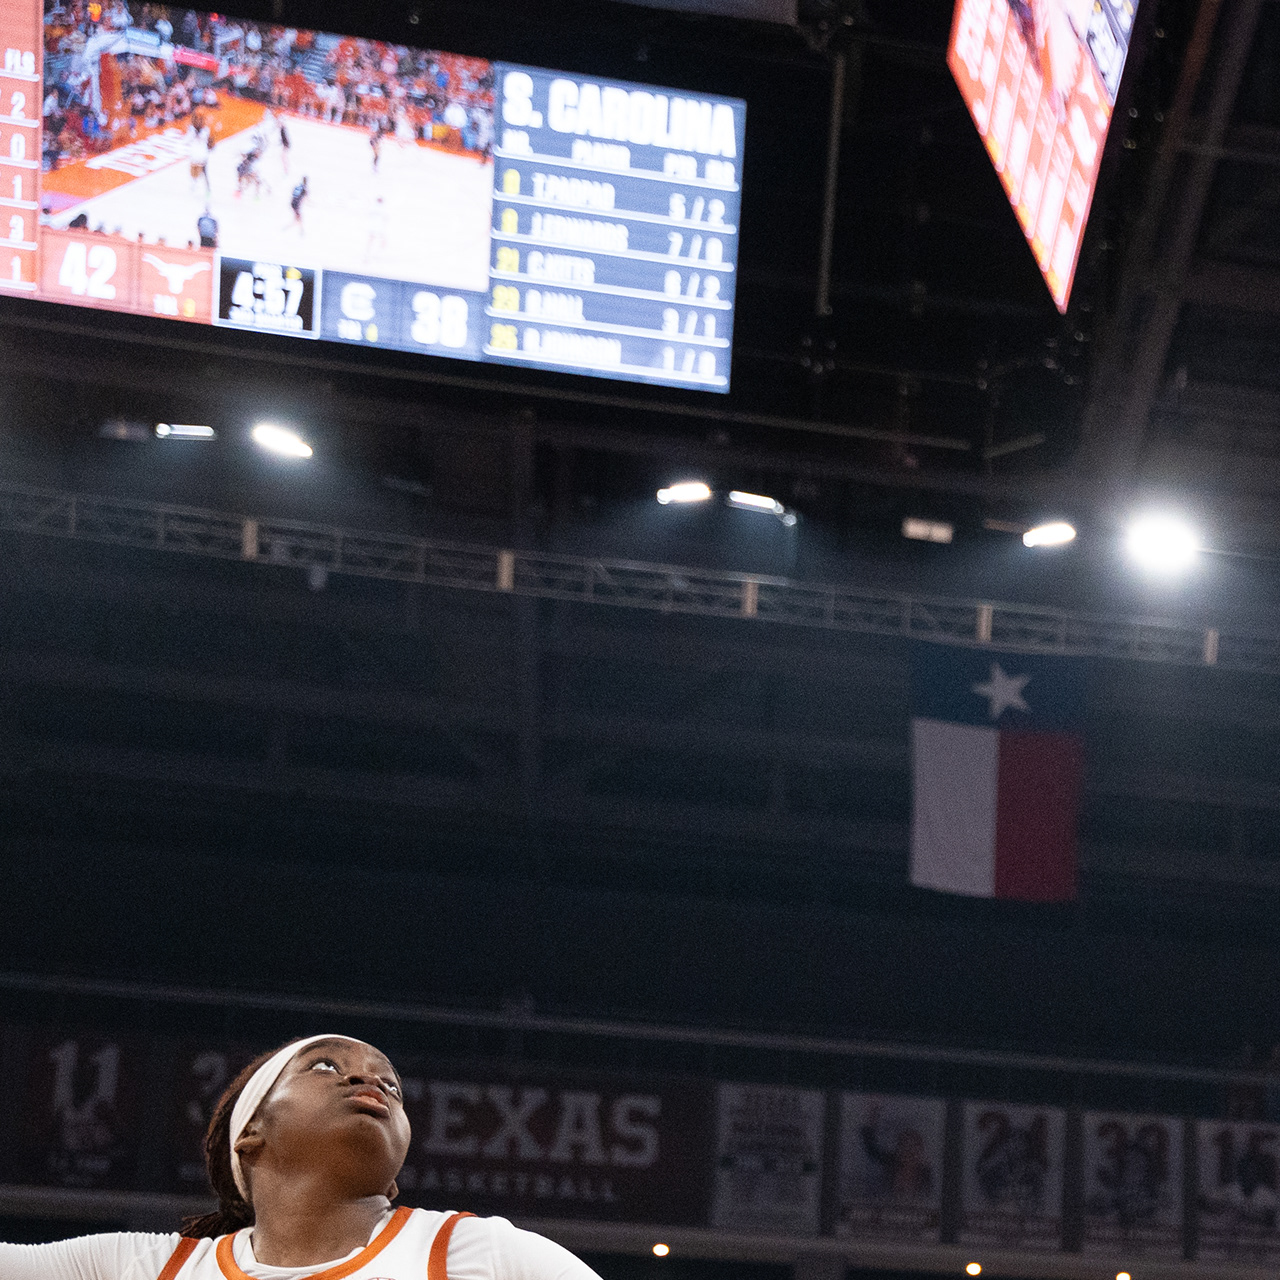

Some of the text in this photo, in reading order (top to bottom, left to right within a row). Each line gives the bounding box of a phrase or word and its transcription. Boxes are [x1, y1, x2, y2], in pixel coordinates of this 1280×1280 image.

[502, 71, 737, 159] S. CAROLINA
[59, 242, 116, 299] 42
[412, 291, 468, 348] 38
[402, 1080, 661, 1167] EXAS
